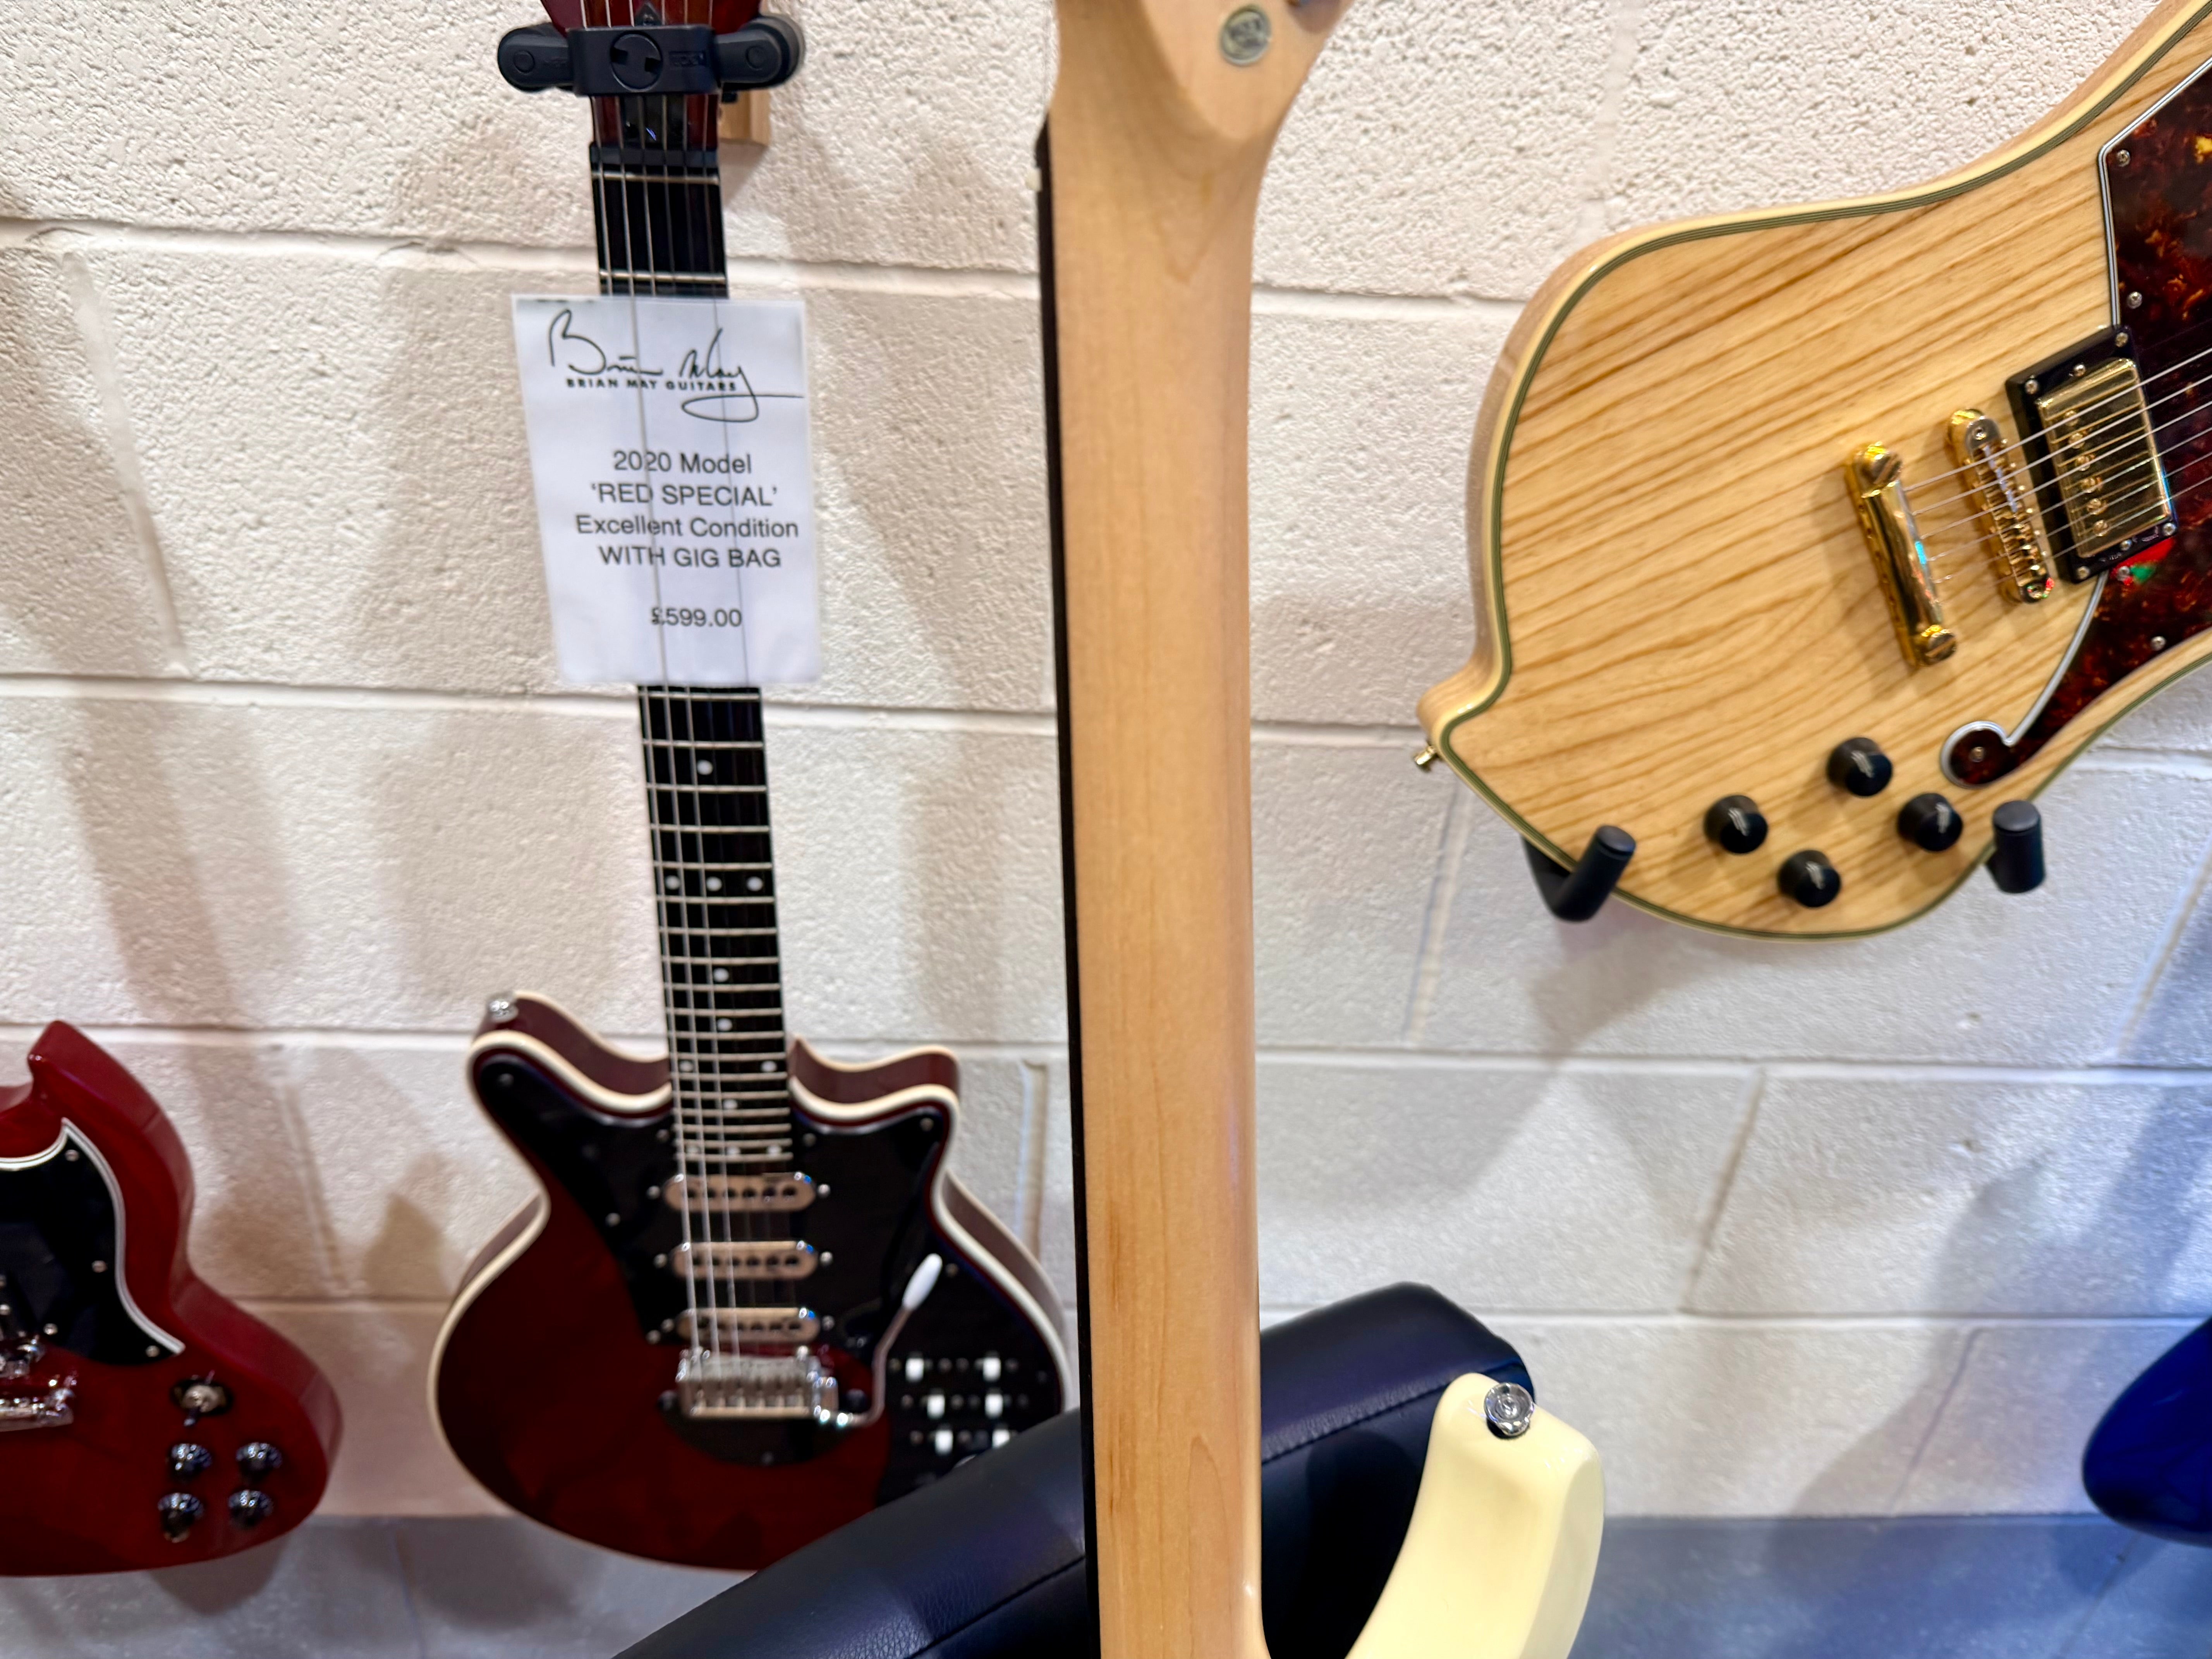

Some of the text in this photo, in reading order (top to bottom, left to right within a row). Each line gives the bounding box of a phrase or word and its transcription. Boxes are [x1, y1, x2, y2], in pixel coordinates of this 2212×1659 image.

[567, 378, 737, 392] BRIAN MAY GUITARS
[613, 450, 751, 474] 2020 Model
[575, 514, 799, 538] Excellent Condition
[599, 546, 781, 568] WITH GIG BAG
[651, 606, 743, 628] £599.00
